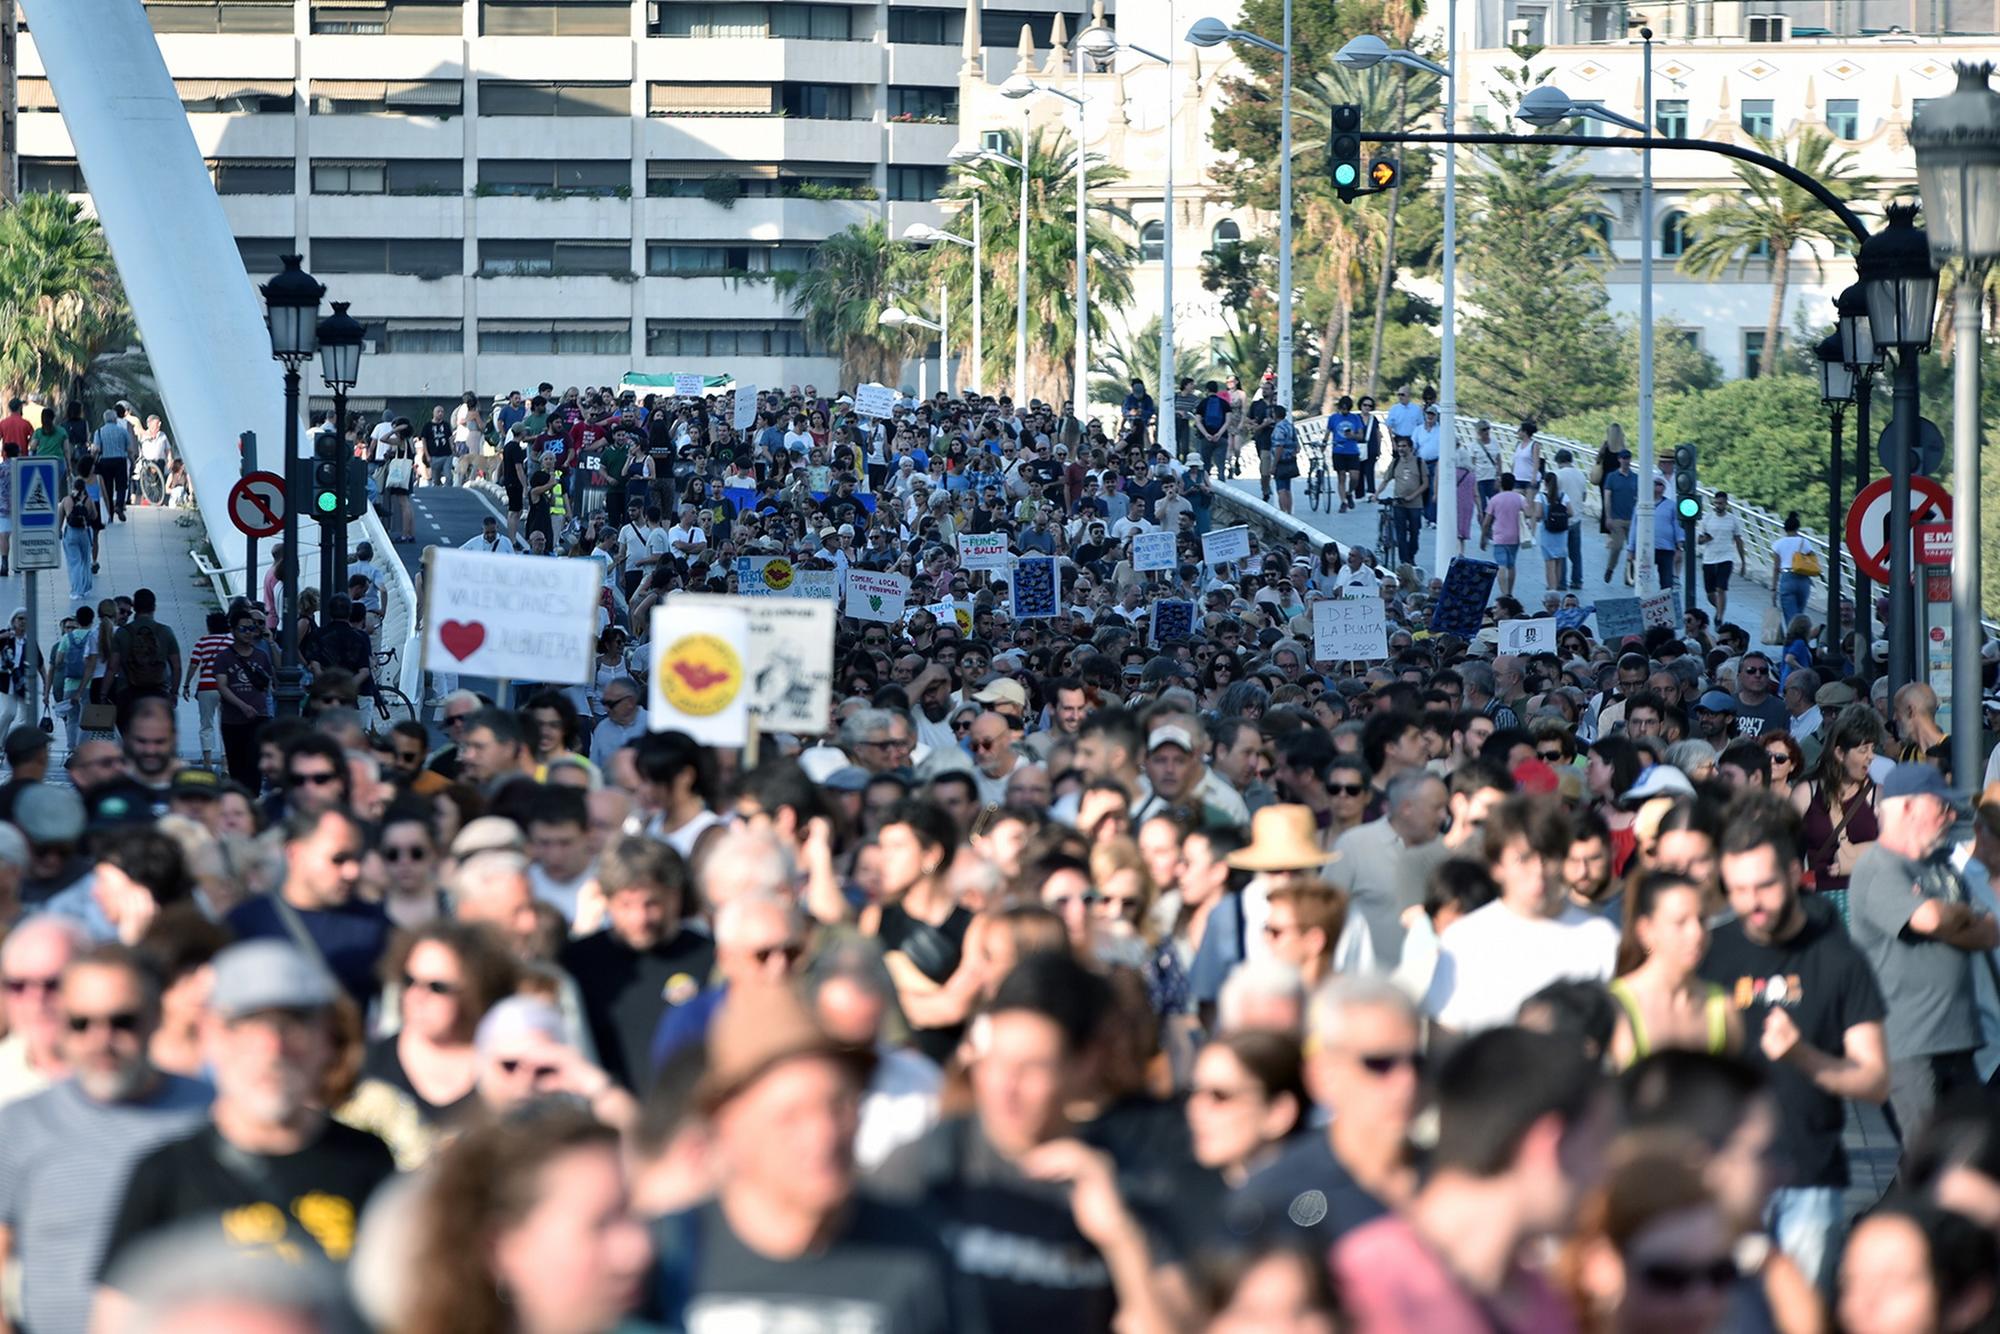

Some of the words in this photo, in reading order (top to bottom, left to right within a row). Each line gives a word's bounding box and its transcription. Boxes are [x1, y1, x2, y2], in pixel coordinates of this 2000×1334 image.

[970, 536, 998, 546] FUMS
[974, 546, 1004, 555] SALUT
[879, 579, 899, 588] LOCAL
[1647, 606, 1668, 619] CASA
[1321, 626, 1338, 637] LA
[1344, 624, 1383, 634] PUNTA
[1737, 716, 1765, 728] ON'T
